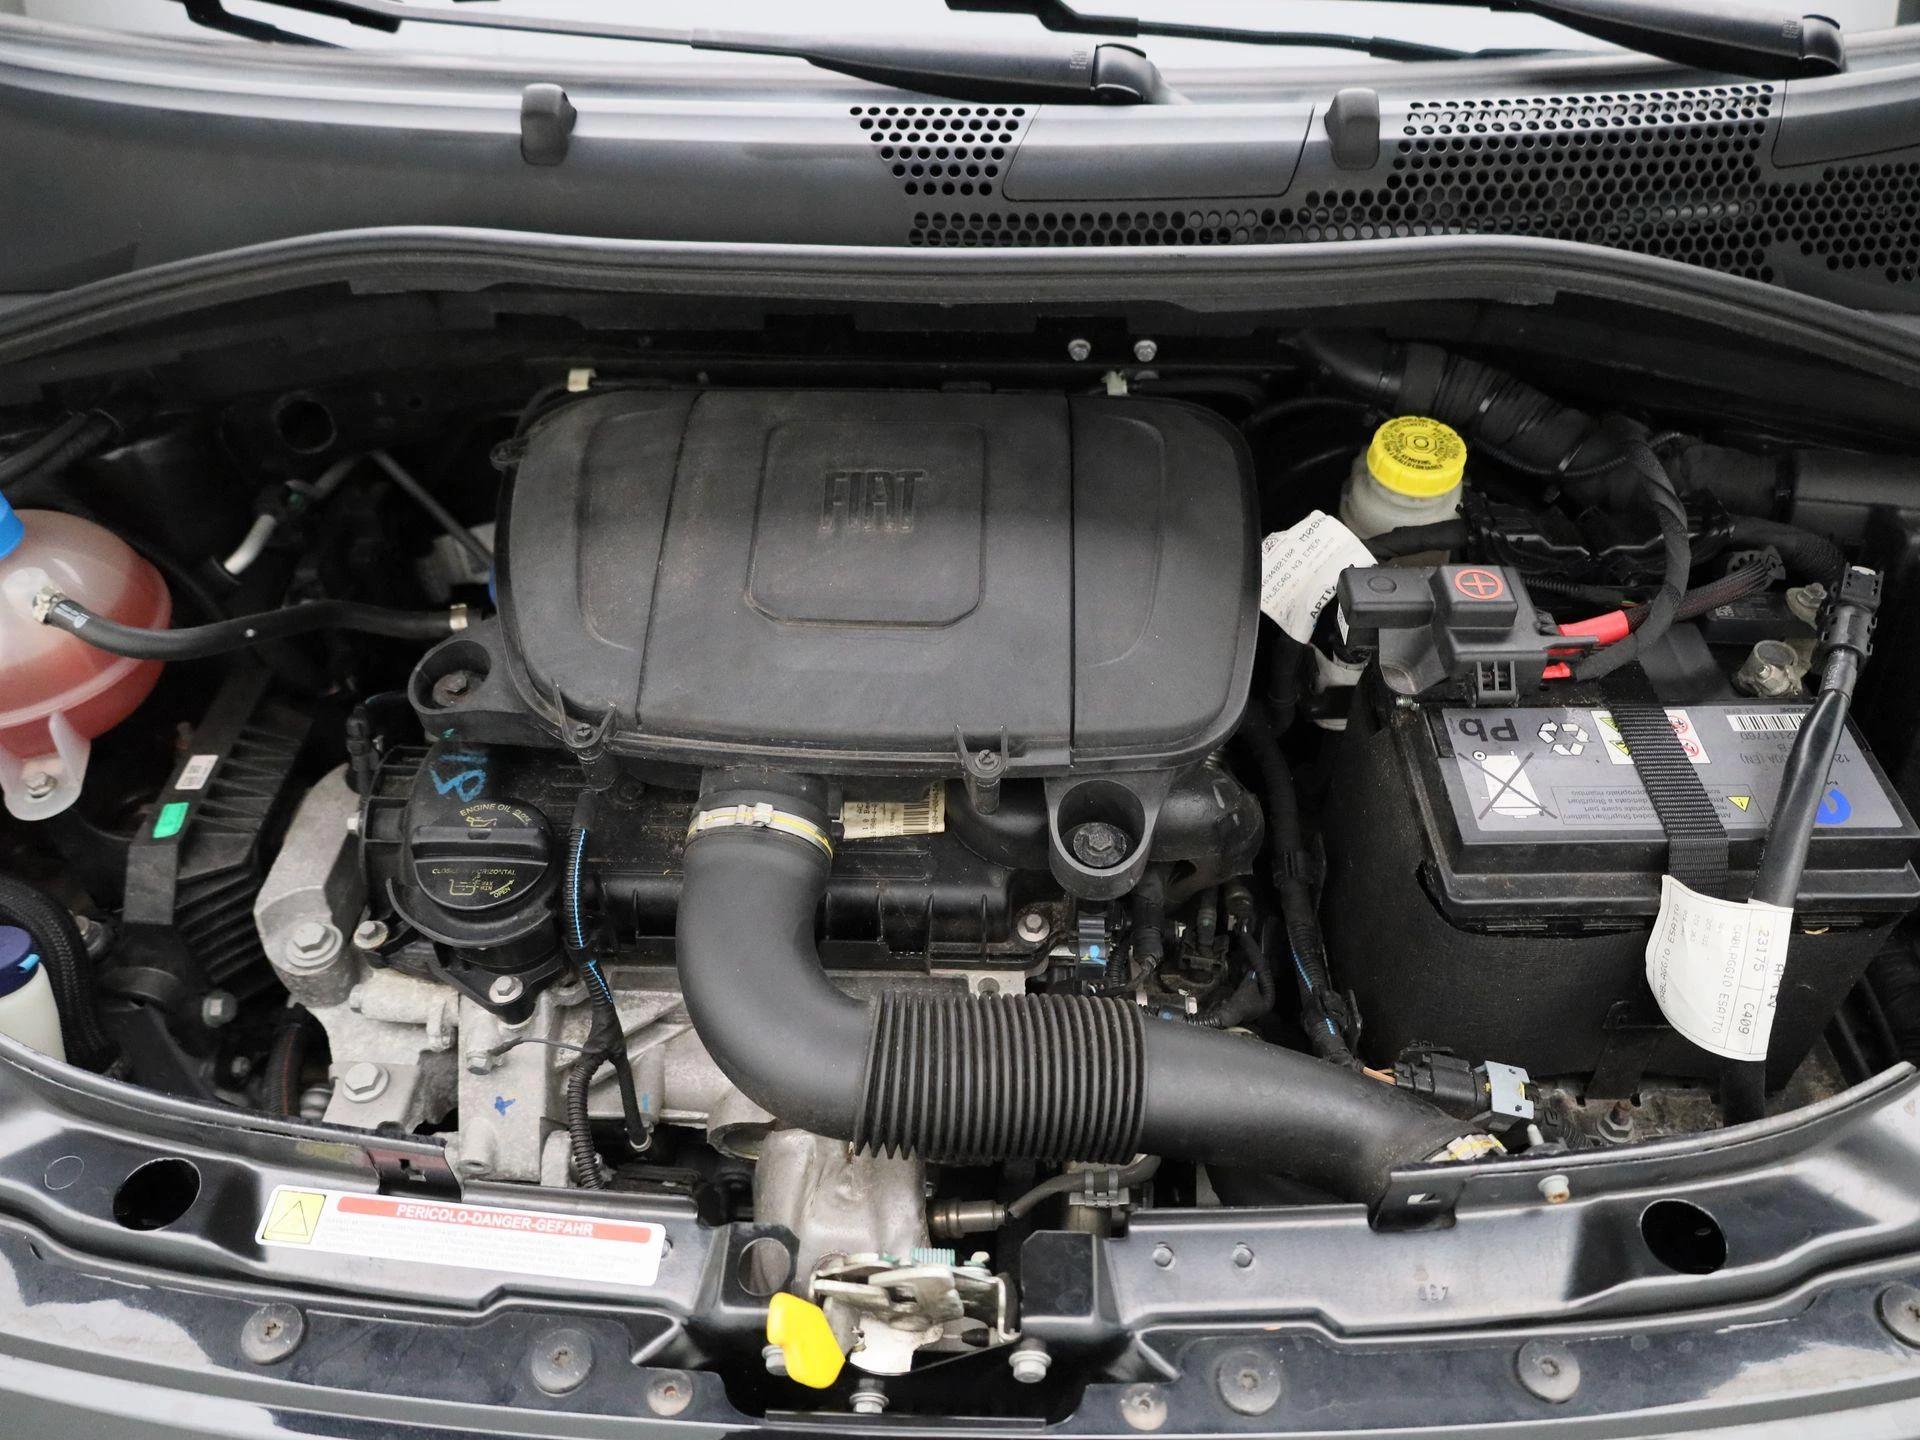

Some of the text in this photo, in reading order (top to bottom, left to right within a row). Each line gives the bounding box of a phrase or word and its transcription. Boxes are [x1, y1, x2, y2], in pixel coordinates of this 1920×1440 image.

[821, 469, 925, 532] FIAT
[1459, 718, 1519, 742] Pb
[460, 803, 512, 817] ENGINE OIL
[493, 886, 512, 899] OPEN
[1711, 923, 1743, 1034] CABLAGGIO ESATTO
[1738, 931, 1770, 1035] 23175 C409
[396, 1203, 594, 1237] PERICOLO-DANGER-GEFAHR
